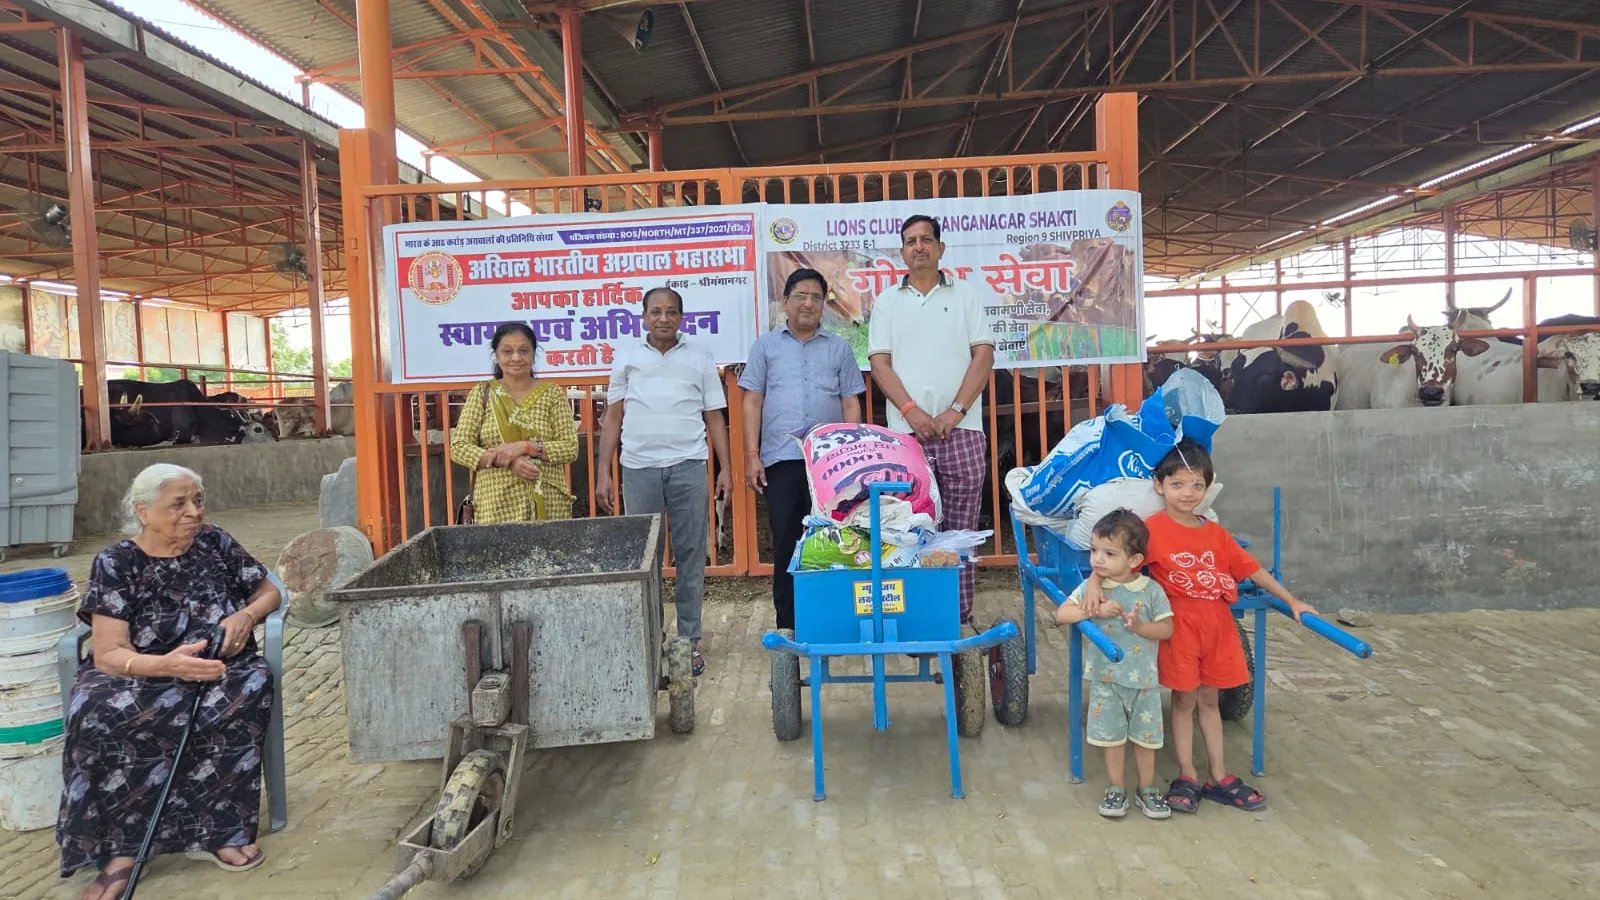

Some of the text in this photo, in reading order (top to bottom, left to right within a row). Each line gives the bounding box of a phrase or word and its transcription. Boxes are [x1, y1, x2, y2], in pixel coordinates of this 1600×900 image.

[826, 219, 866, 237] LIONS
[869, 217, 903, 235] CLUB
[1029, 209, 1077, 228] SHAKTI
[404, 239, 422, 249] भारत
[496, 234, 506, 245] की
[803, 239, 876, 251] District 3233 E-1
[1006, 228, 1102, 245] Region 9 SHIVPRIYA
[468, 253, 531, 280] अखिल
[533, 249, 600, 276] भारतीय
[602, 250, 673, 274] अग्रवाल
[673, 246, 747, 270] महासभा
[981, 253, 1073, 294] सेवा
[698, 275, 748, 288] श्रीगंगानगर
[511, 282, 644, 310] आपका हार्दिक
[531, 309, 575, 343] एवं
[992, 320, 1007, 333] की
[1008, 320, 1029, 333] सेवा
[545, 342, 615, 367] करती है
